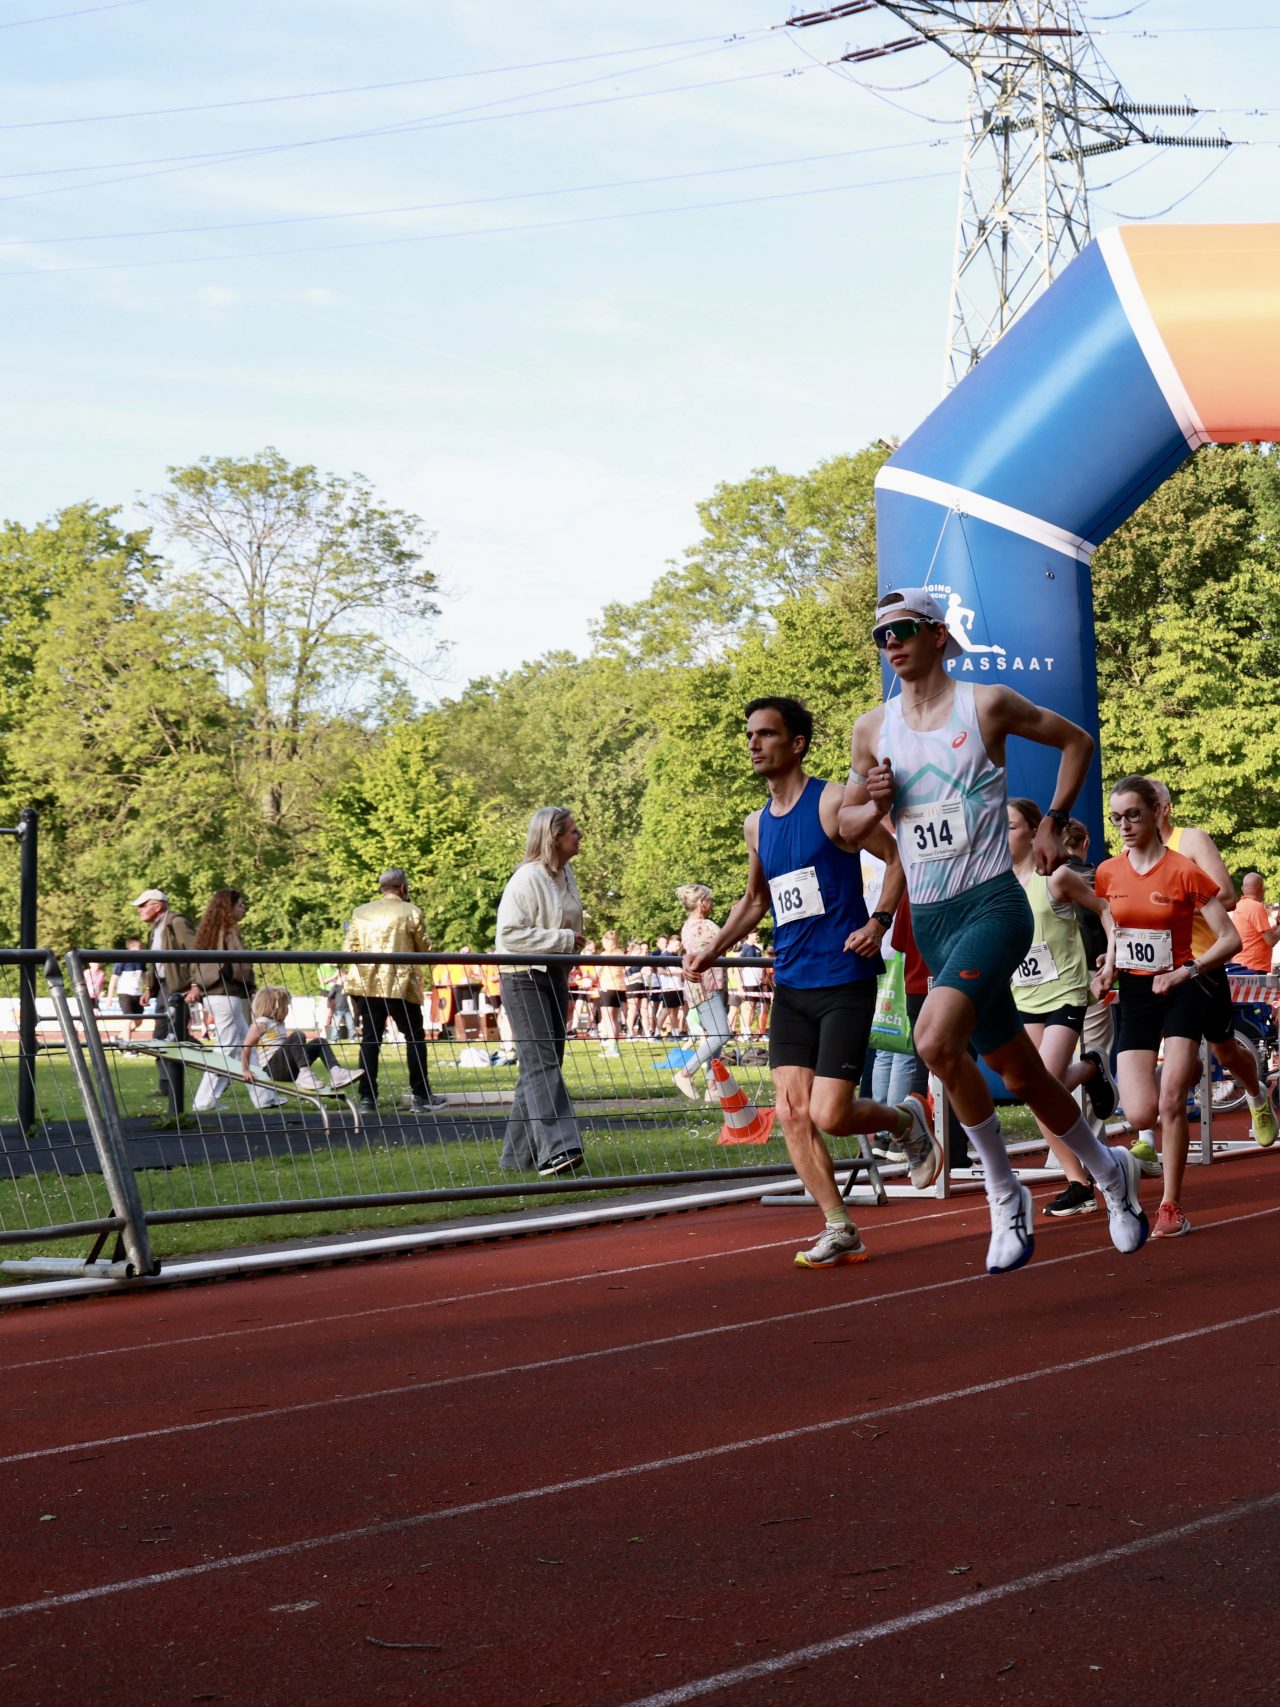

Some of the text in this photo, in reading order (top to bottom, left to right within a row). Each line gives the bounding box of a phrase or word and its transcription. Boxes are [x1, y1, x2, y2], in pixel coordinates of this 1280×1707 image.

[946, 656, 1054, 672] PASSAAT
[913, 819, 953, 850] 314
[778, 887, 803, 914] 183
[1127, 941, 1155, 963] 180
